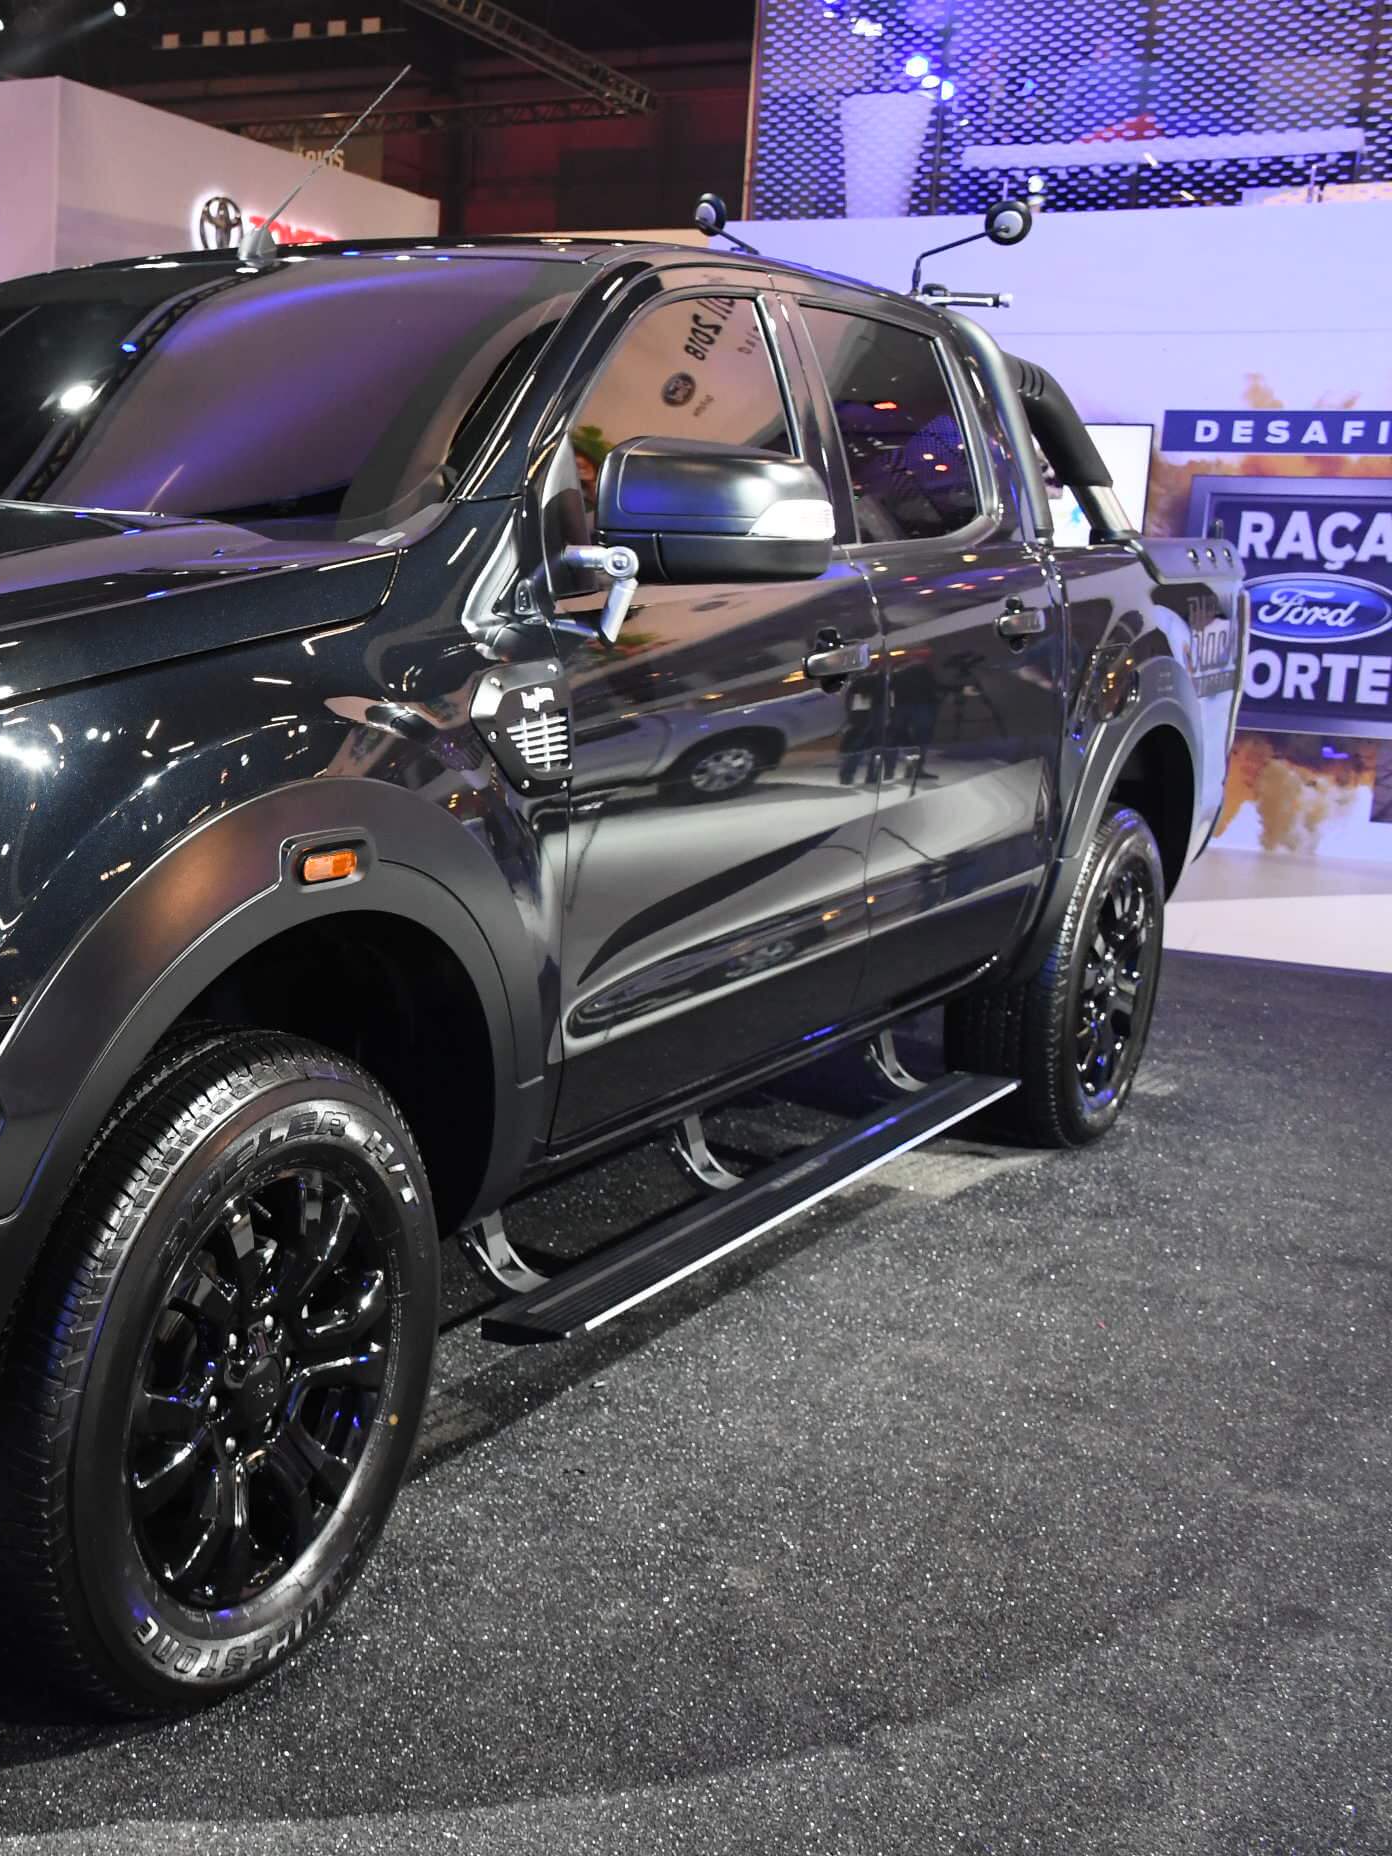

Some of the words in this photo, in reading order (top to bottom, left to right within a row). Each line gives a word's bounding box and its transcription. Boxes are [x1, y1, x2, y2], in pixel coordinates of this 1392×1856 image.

[1237, 510, 1392, 571] RAÇA
[1257, 586, 1361, 629] Ford
[1242, 649, 1392, 705] ORTE
